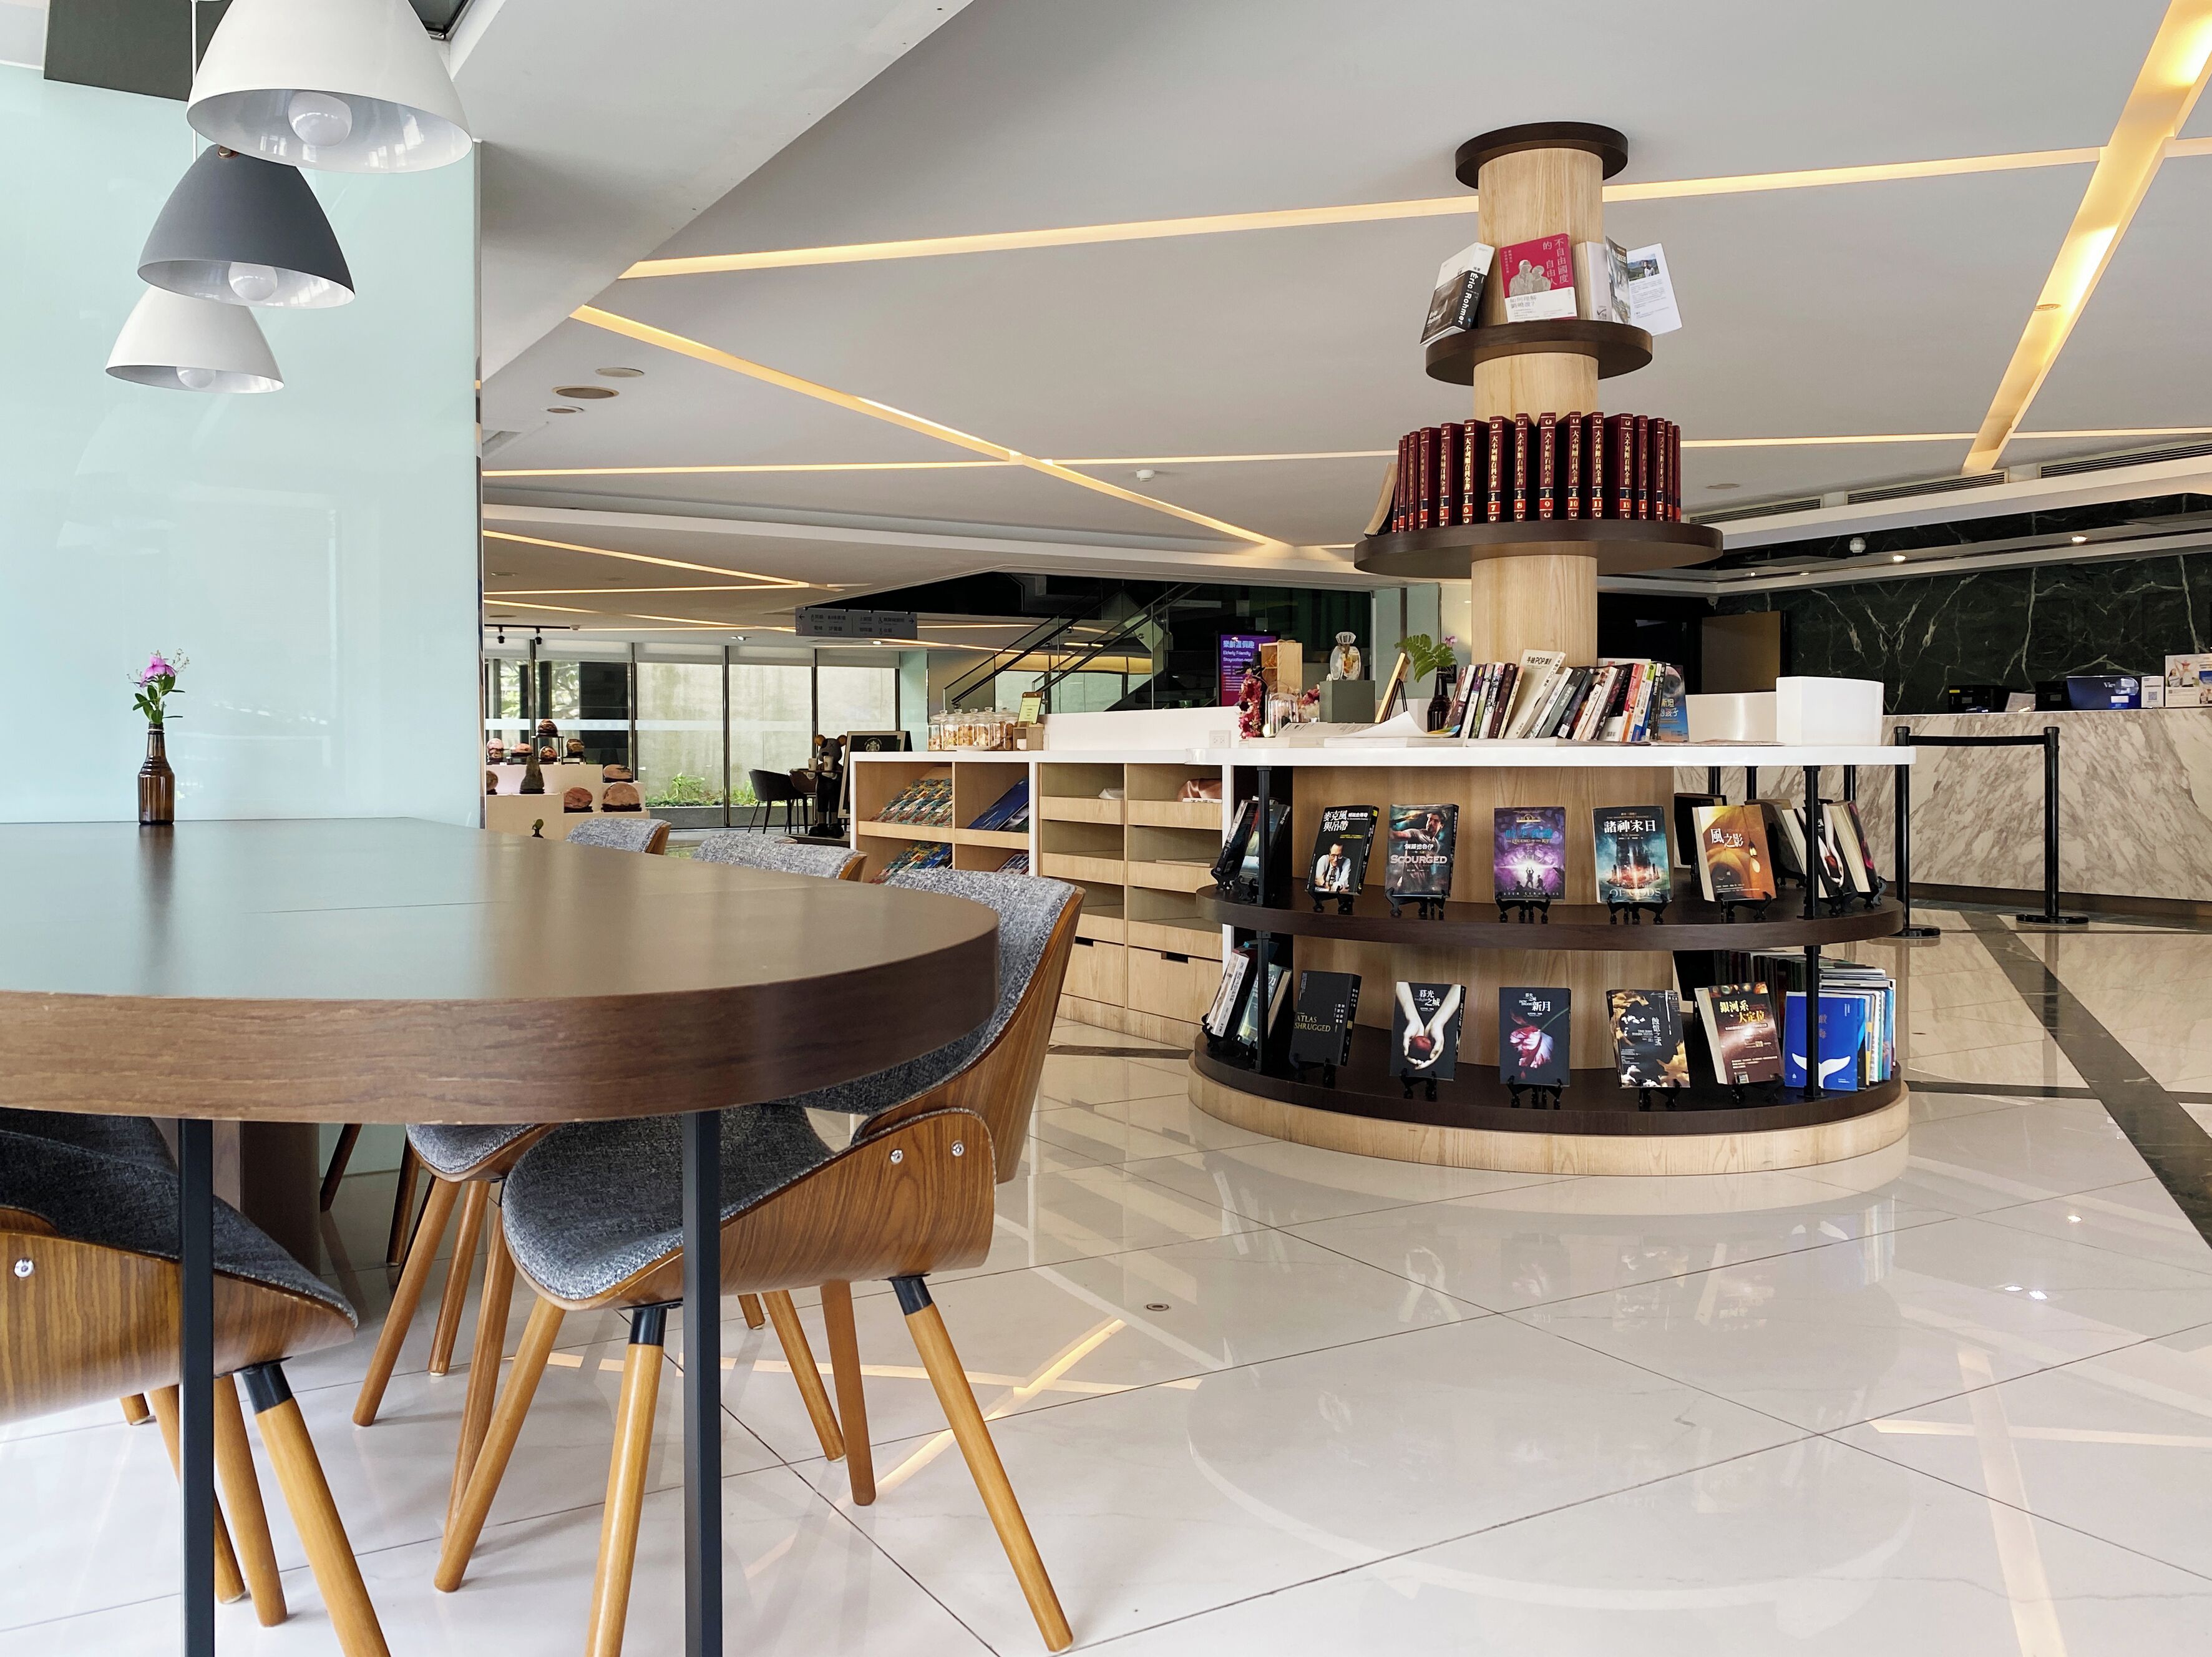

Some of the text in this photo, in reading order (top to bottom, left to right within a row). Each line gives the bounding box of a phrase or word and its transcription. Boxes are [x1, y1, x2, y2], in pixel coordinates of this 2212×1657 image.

[1542, 241, 1557, 285] 的 自由人
[1554, 238, 1569, 283] 不自由國度
[1458, 292, 1472, 325] Rohmer
[1323, 821, 1348, 832] 與吊帶
[1604, 819, 1656, 833] 諸神末日
[1710, 828, 1744, 848] 風之影
[1390, 854, 1448, 864] SCOURGED
[1629, 888, 1661, 897] GODS
[1425, 998, 1440, 1006] 之城
[1532, 1001, 1551, 1012] 新月
[1719, 999, 1749, 1013] 銀河系
[1297, 1015, 1317, 1023] ATLAS
[1737, 1010, 1765, 1024] 大定位
[1294, 1022, 1331, 1032] SHRUGGED
